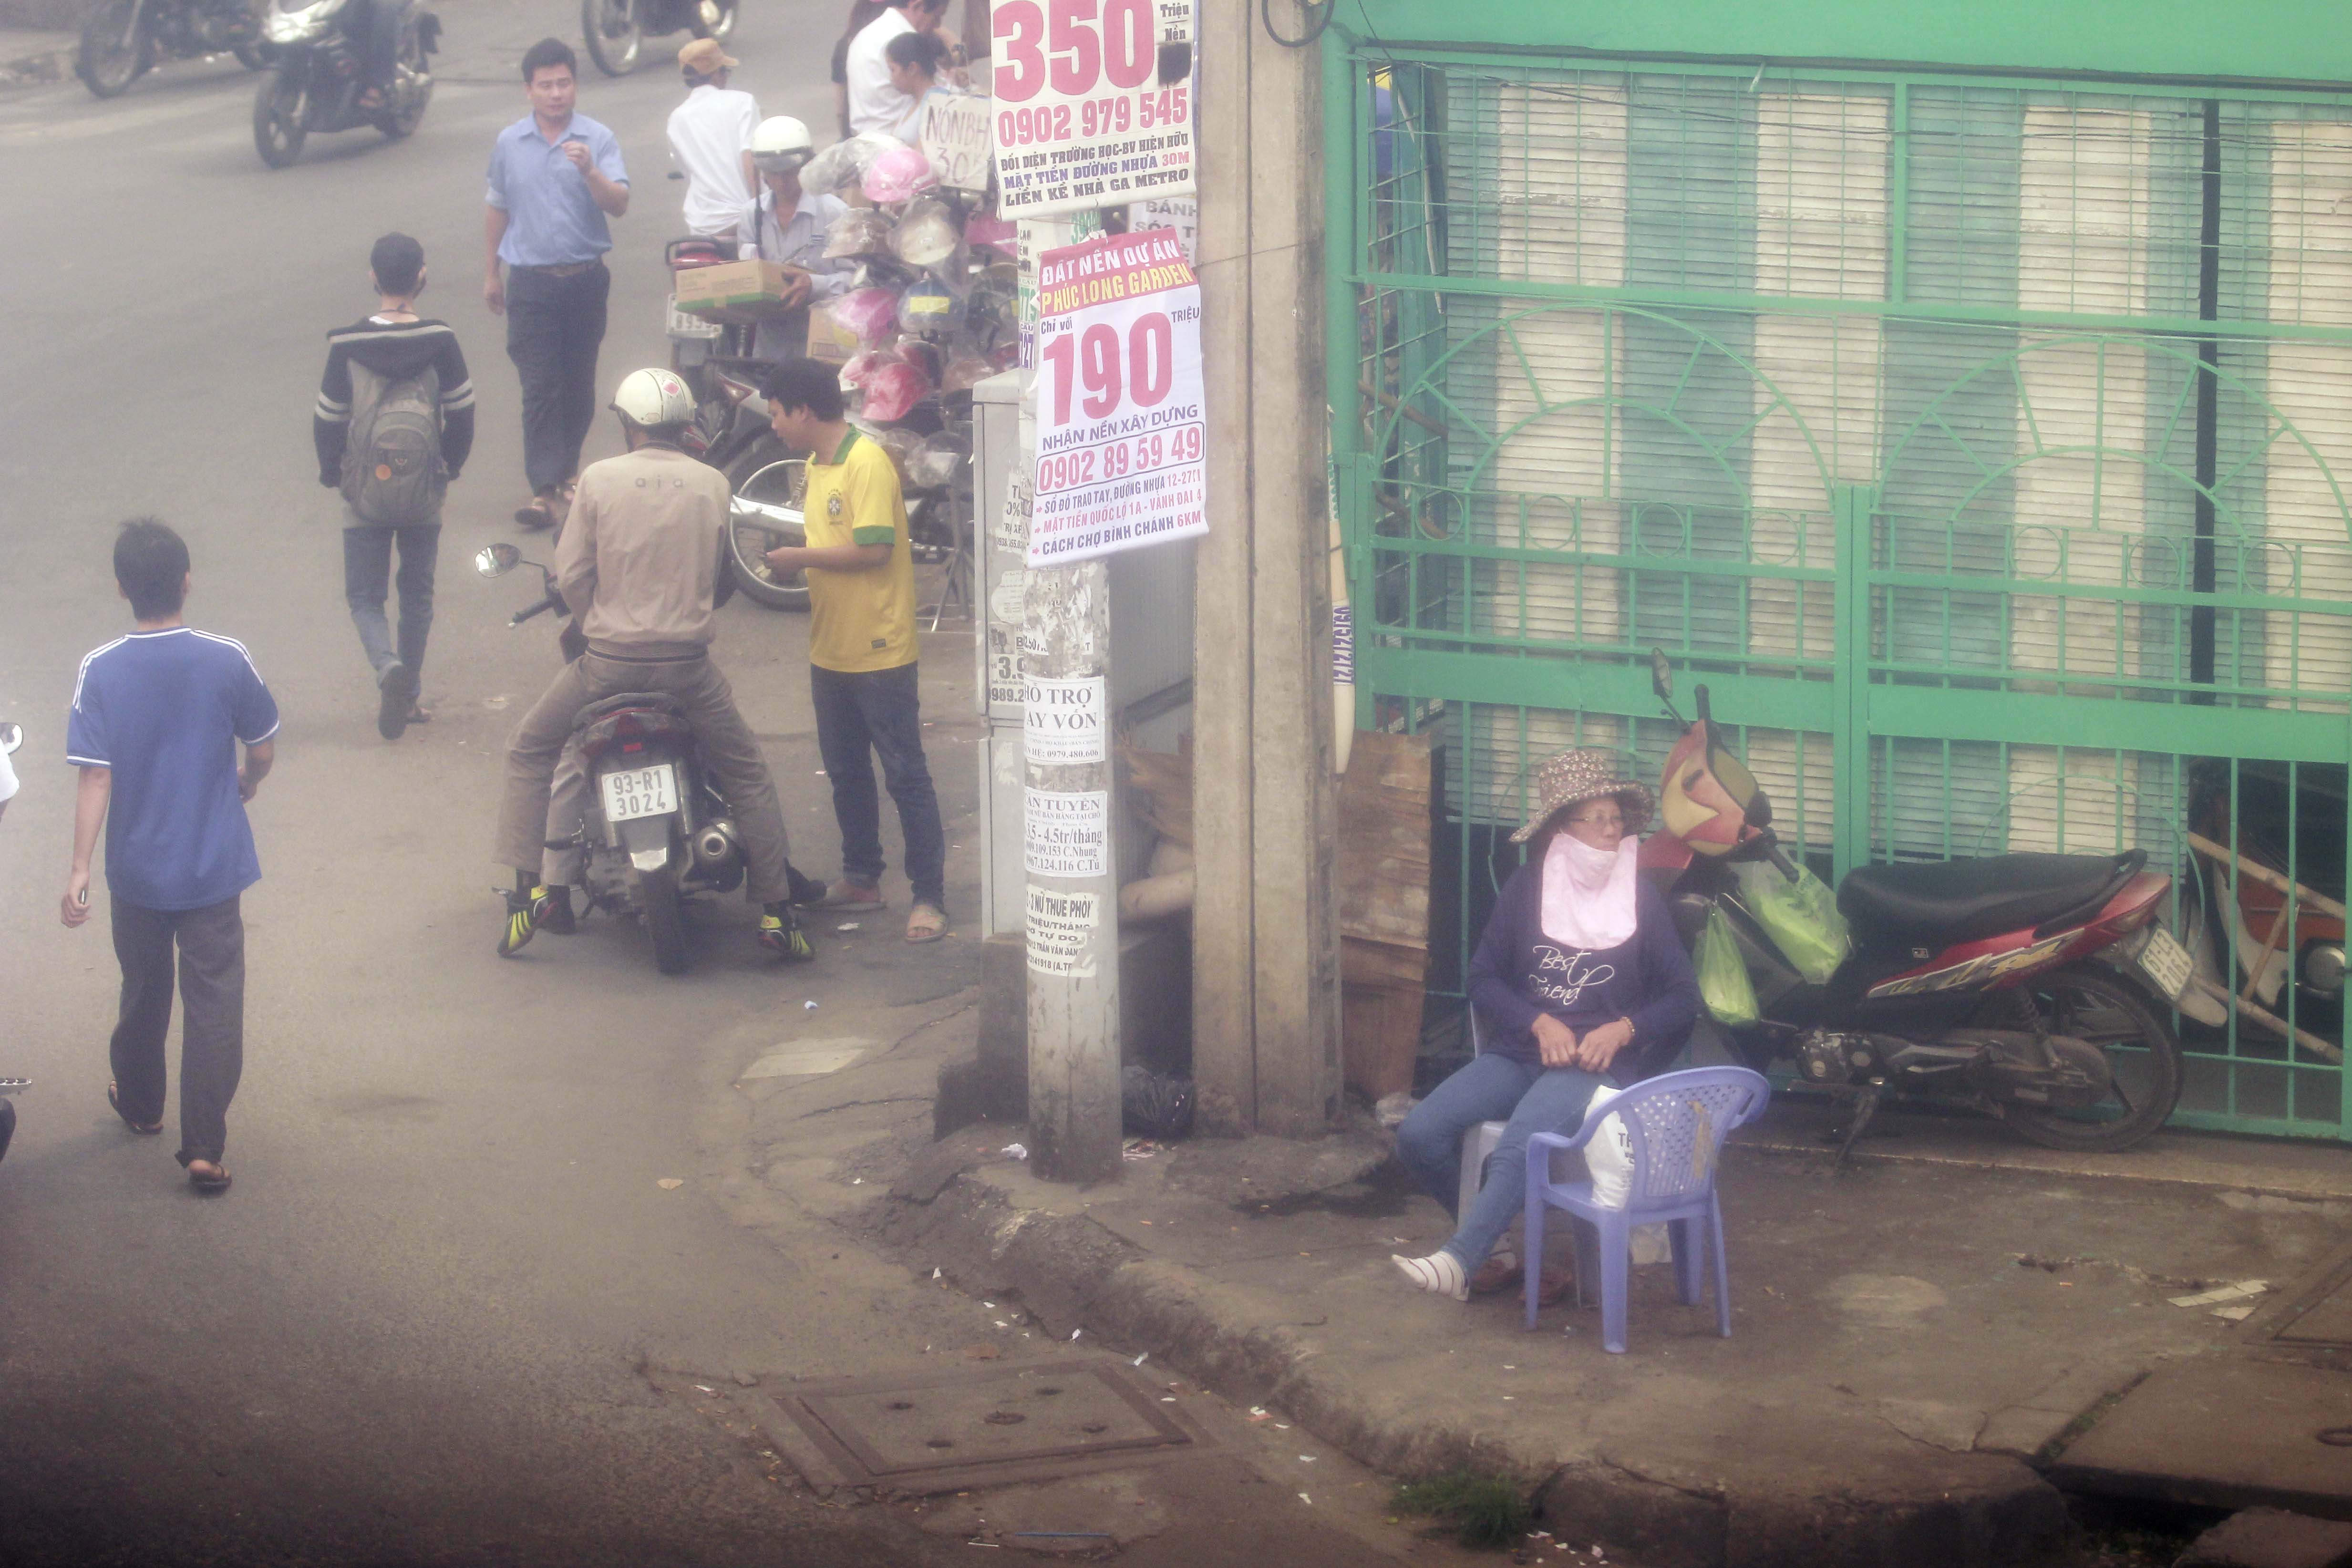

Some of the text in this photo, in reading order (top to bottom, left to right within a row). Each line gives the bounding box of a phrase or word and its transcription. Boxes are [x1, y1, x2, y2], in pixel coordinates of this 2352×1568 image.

[1160, 2, 1189, 19] Triệu
[1165, 24, 1186, 41] Nền
[993, 0, 1155, 102] 350
[998, 88, 1187, 147] 0902 979 545
[1022, 151, 1046, 170] DIỆN
[1051, 146, 1095, 164] TRƯỜNG
[1098, 143, 1135, 160] HỌC-BV
[1073, 161, 1117, 179] ĐƯỜNG
[1122, 154, 1158, 173] NHỰA
[1162, 152, 1189, 166] 30M
[1074, 178, 1105, 197] NHÀ
[1110, 177, 1130, 191] GA
[1135, 168, 1188, 187] METRO
[1042, 259, 1075, 286] ĐẤT
[1080, 248, 1120, 276] NỀN
[1124, 242, 1150, 267] DỰ
[1153, 238, 1179, 261] ÁN
[1042, 263, 1193, 314] PHÚC LONG GARDEN
[1041, 318, 1056, 334] Chỉ
[1043, 306, 1199, 426] 190 TRIỆU
[1043, 404, 1198, 450] NHẬN NỀN XÂY DỰNG
[1040, 427, 1200, 491] 0902 89 59 49
[1073, 494, 1092, 509] TRAO
[1114, 480, 1141, 499] ĐƯỜNG
[1144, 476, 1165, 493] NHỰA
[1043, 516, 1065, 534] MẶT
[1066, 509, 1087, 529] TIỀN
[1090, 504, 1114, 525] QUỐC
[1129, 501, 1142, 516] 1A
[1150, 491, 1174, 511] VÀNH
[1176, 490, 1193, 505] ĐAI
[1042, 511, 1201, 555] CÁCH CHỢ BÌNH CHÁNH 6KM
[1047, 686, 1093, 708] TRỢ
[1053, 709, 1097, 729] VỐN
[1047, 750, 1099, 758] 0979.480.606
[613, 770, 662, 795] 93-R1
[616, 791, 666, 816] 3024
[1044, 827, 1102, 846] 4.5tr/tháng
[1063, 846, 1097, 858] C.Nhung
[1533, 946, 1614, 986] Best
